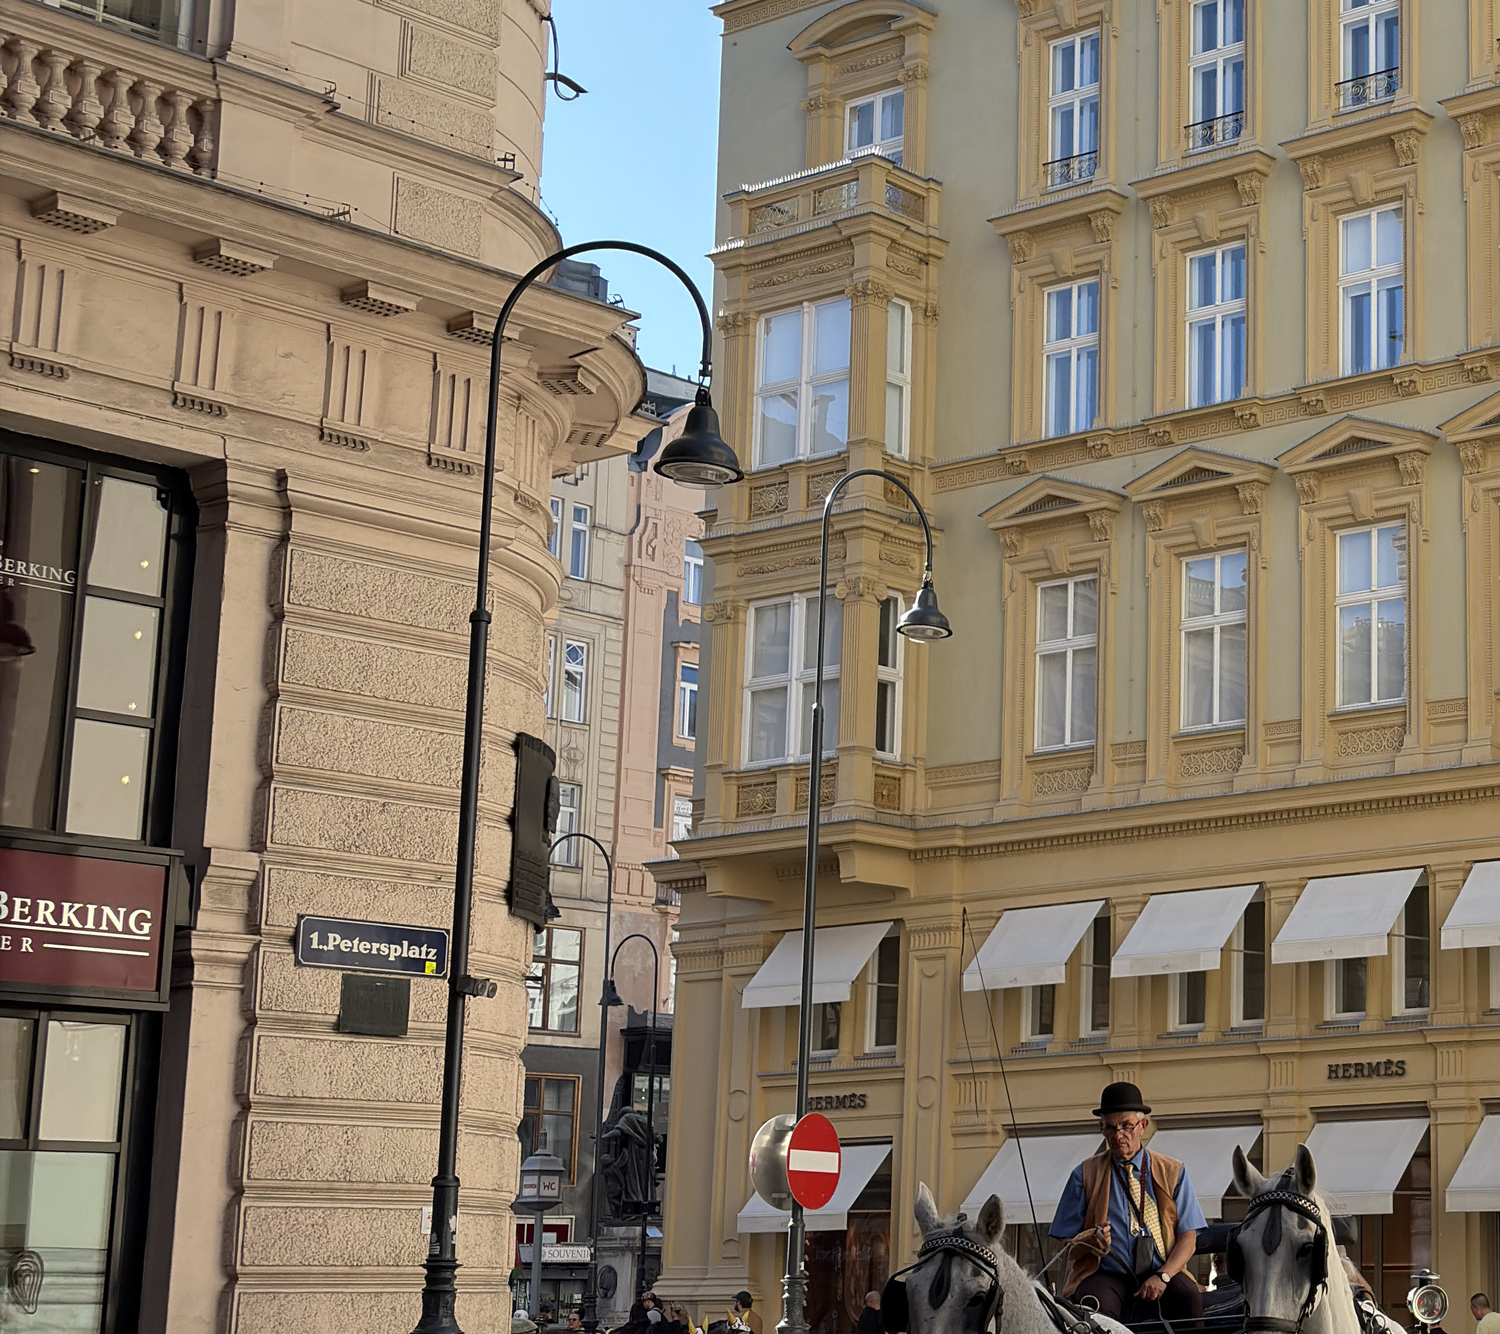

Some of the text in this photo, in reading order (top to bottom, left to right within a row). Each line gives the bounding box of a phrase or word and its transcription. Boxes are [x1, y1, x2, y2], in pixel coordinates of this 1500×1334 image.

[0, 554, 76, 584] ERKING
[1327, 1058, 1406, 1080] HERMÈS
[543, 1181, 556, 1191] WC
